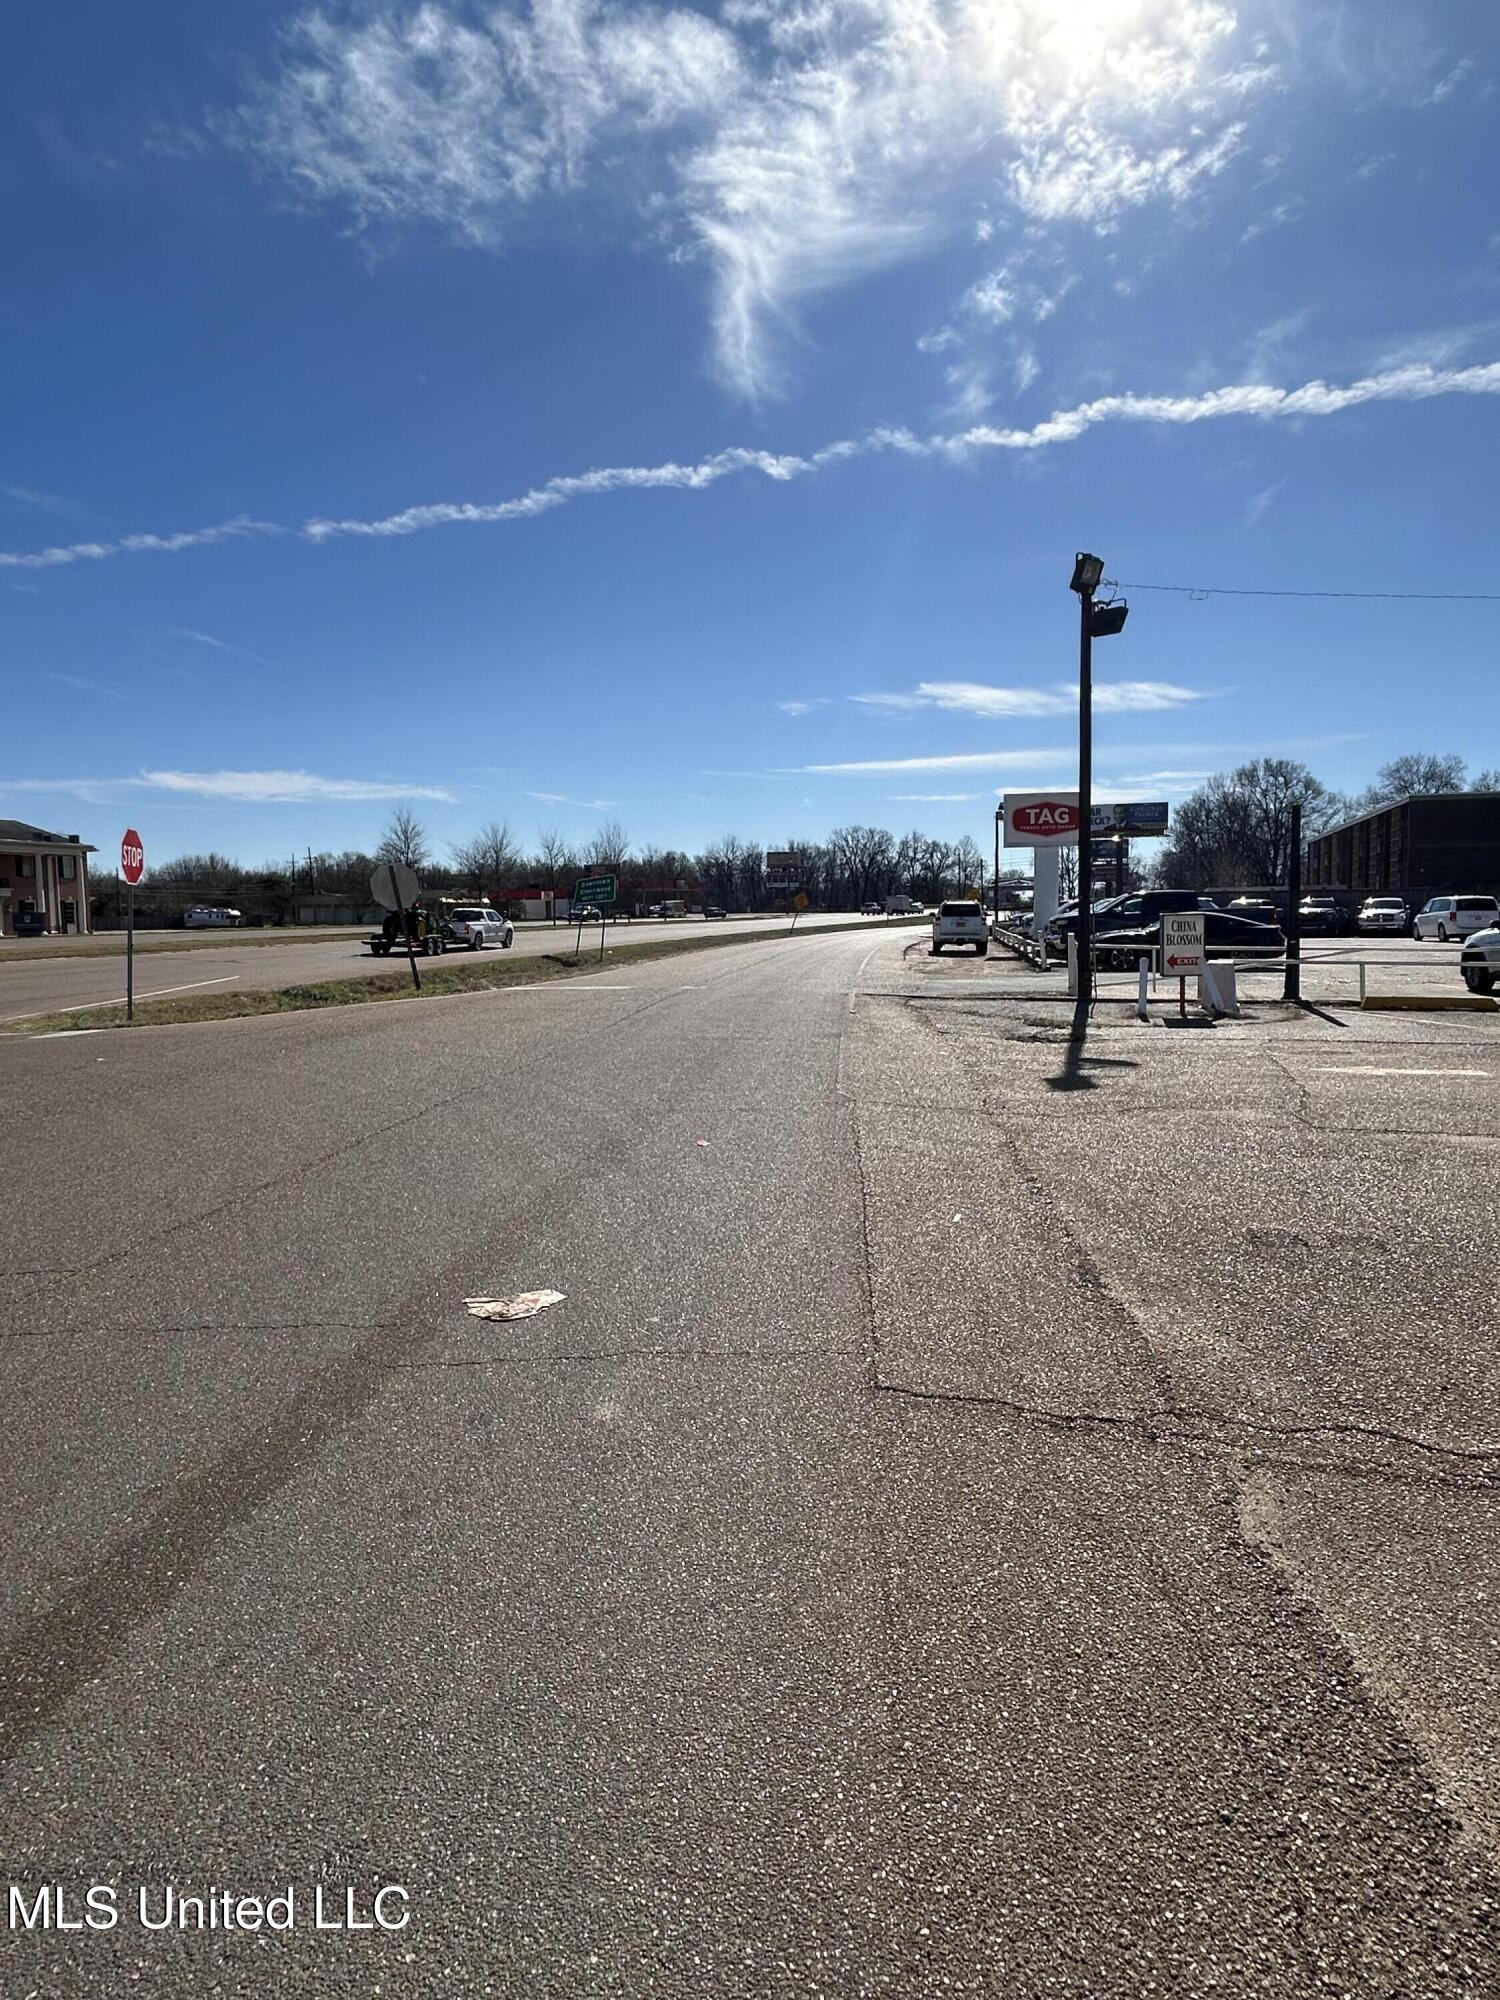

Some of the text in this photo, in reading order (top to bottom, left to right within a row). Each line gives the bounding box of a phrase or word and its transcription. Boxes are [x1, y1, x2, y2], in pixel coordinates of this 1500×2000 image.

[1025, 808, 1069, 824] TAG
[1091, 808, 1102, 816] AR
[1091, 816, 1111, 825] ECK?
[122, 845, 143, 867] STOP
[1171, 919, 1197, 932] CHINA
[1166, 933, 1202, 946] BLOSSOM
[1177, 957, 1198, 966] EXIT
